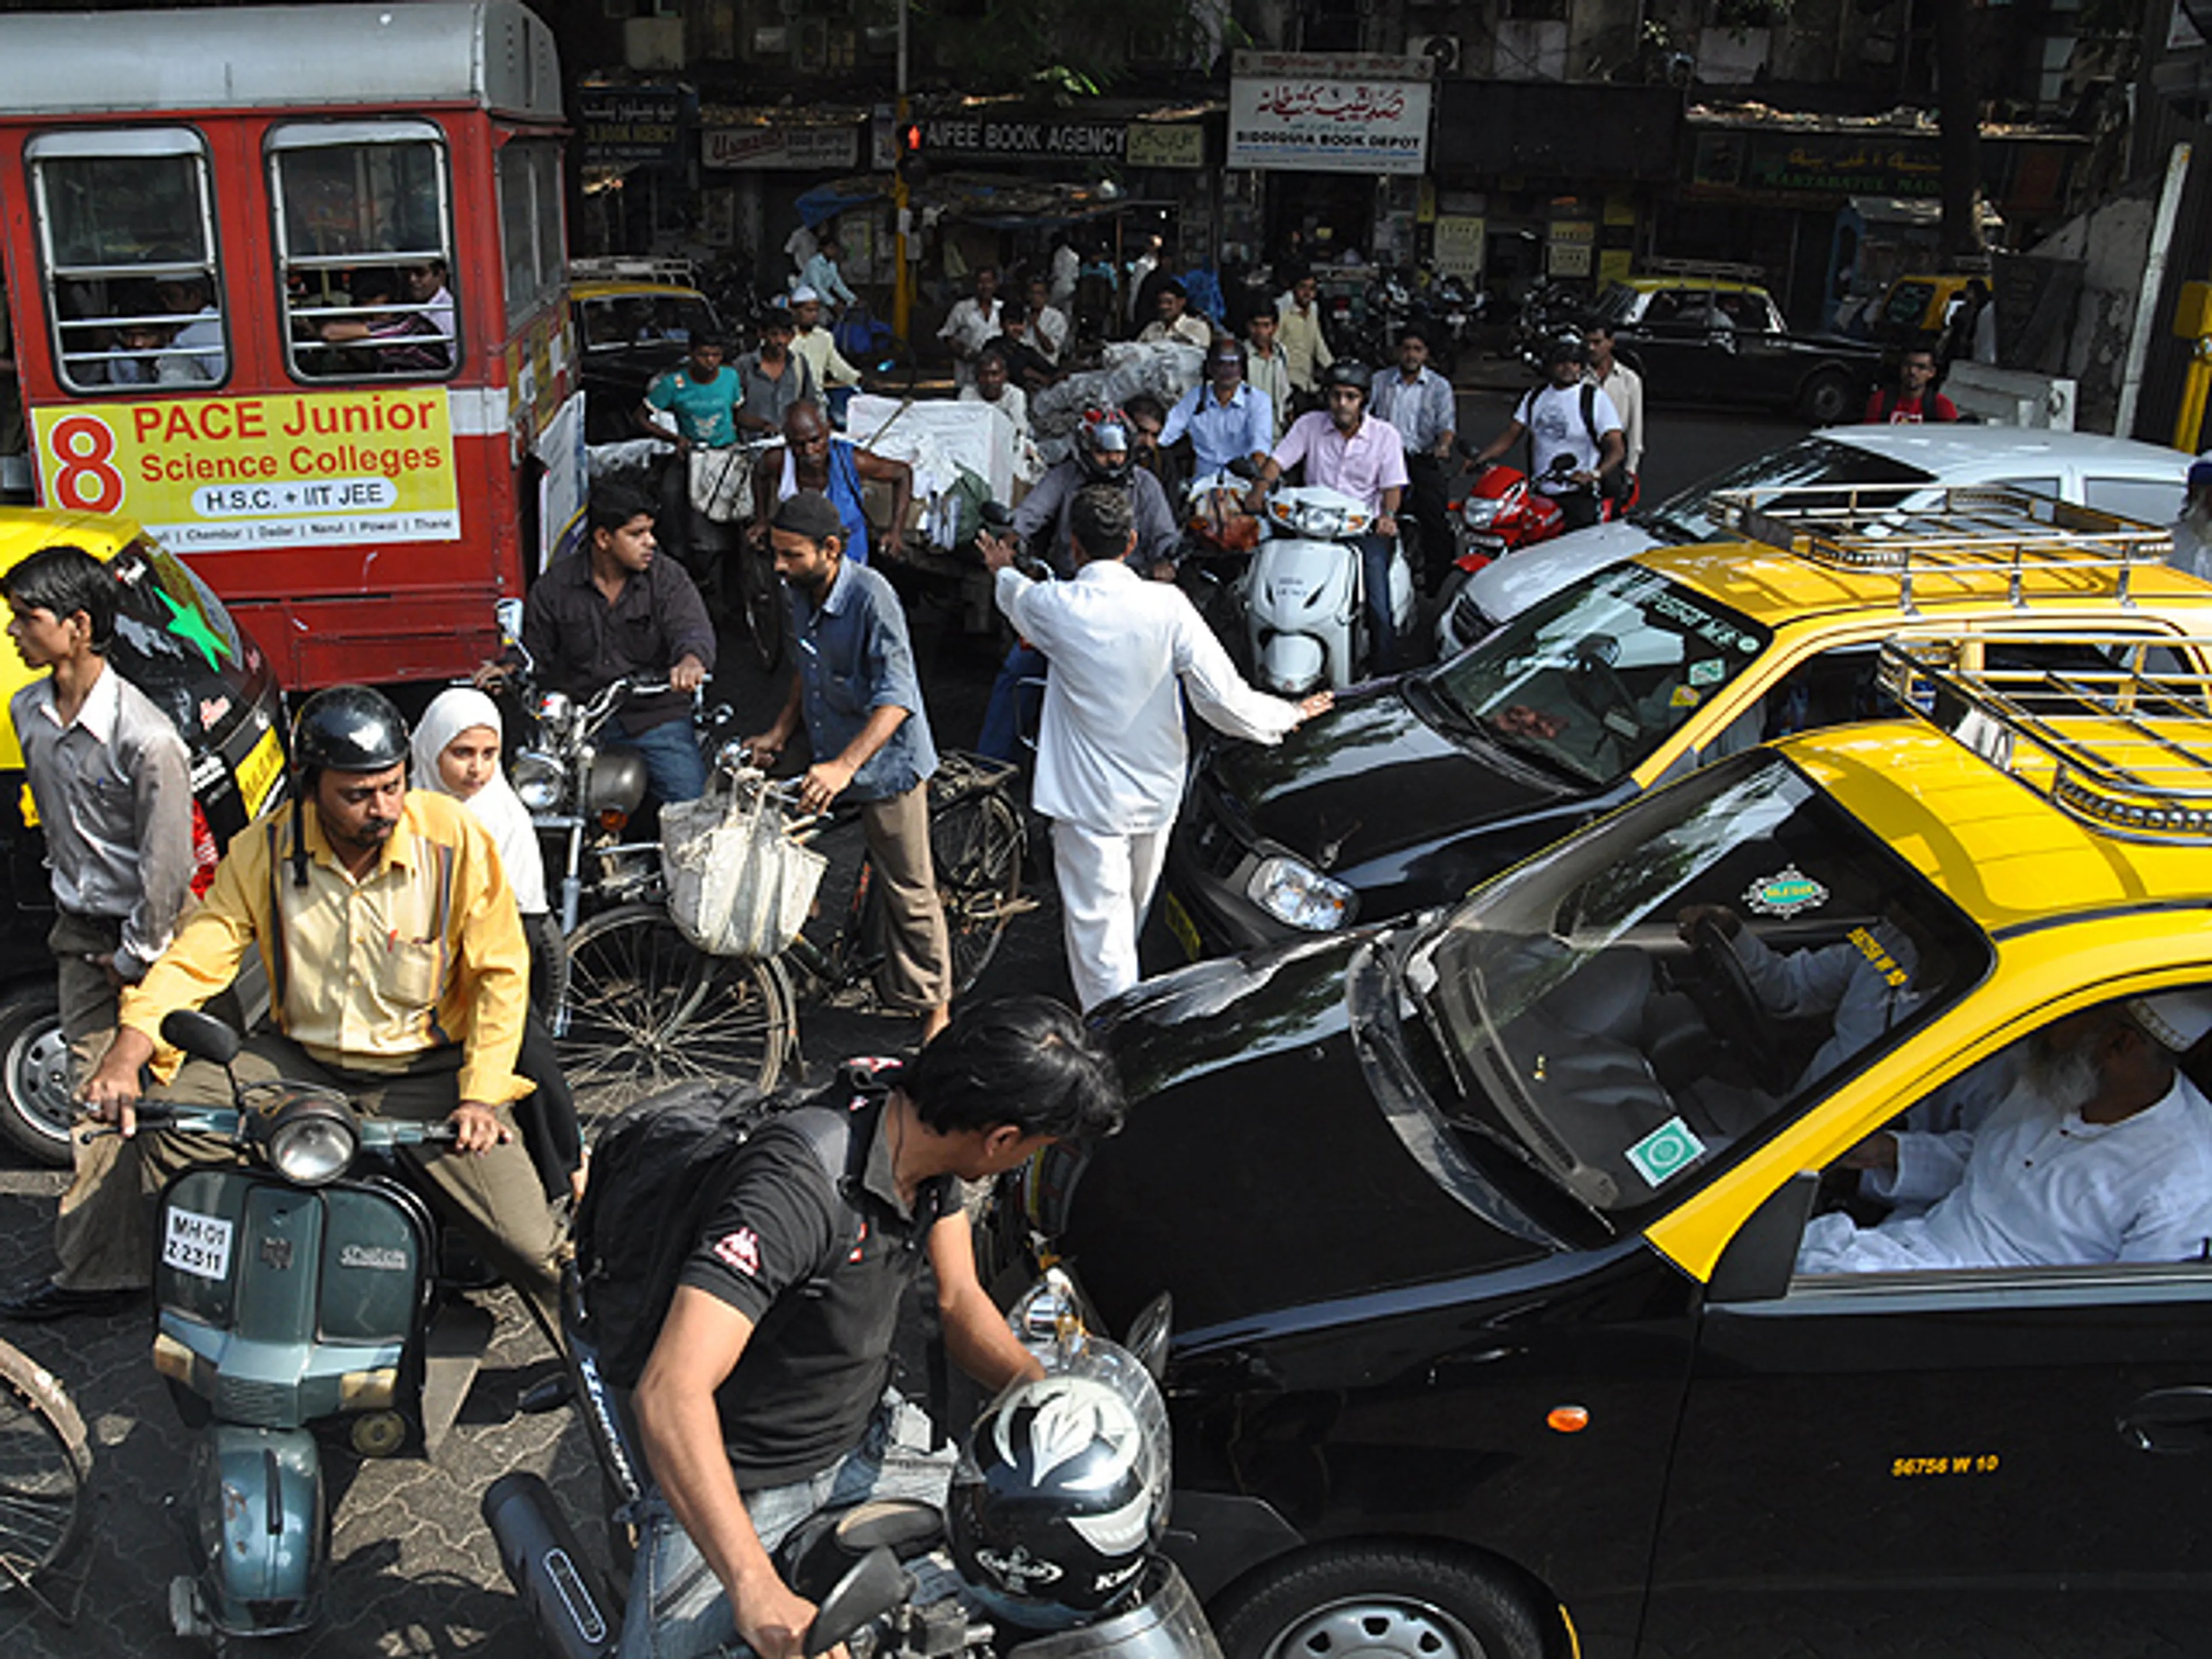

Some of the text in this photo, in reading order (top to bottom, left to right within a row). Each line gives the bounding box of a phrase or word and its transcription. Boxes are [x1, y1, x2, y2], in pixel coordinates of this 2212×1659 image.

[984, 123, 1041, 152] BOOK
[1046, 124, 1128, 156] AGENCY
[1321, 132, 1365, 146] BOOK
[1369, 135, 1421, 149] DEPOT
[132, 395, 436, 444] PACE Junior
[51, 415, 123, 514] 8
[141, 445, 442, 482] Science Colleges
[206, 488, 278, 511] H.S.C.
[304, 485, 332, 506] IIT
[338, 483, 384, 505] JEE
